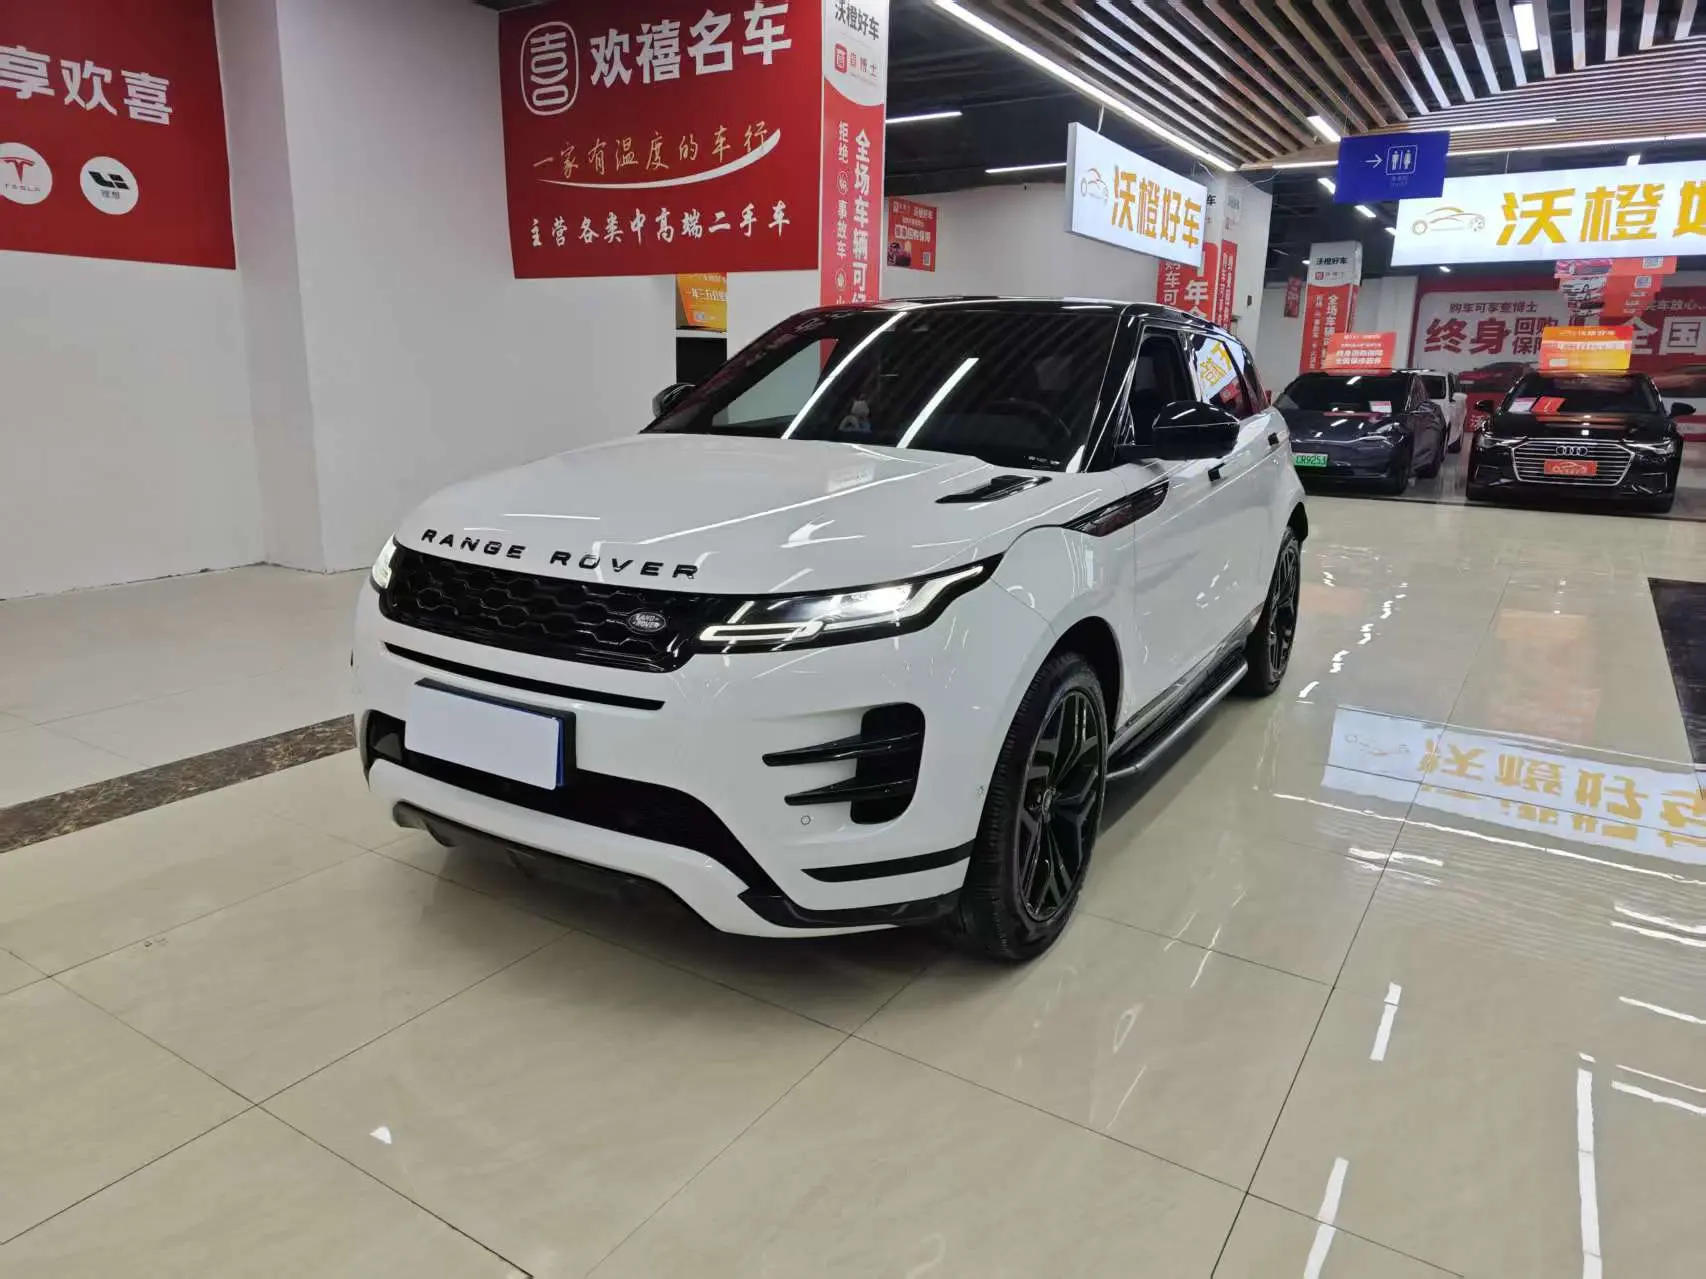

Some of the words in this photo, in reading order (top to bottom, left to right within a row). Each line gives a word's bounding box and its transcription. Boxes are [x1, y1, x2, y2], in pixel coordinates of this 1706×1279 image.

[590, 0, 792, 88] 欢禧名车
[834, 0, 880, 40] 沃橙好车
[0, 45, 173, 125] 享欢喜
[533, 120, 768, 179] 一家有温度的车行
[838, 121, 849, 164] 拒绝
[529, 200, 790, 247] 主营各类中高端二手车
[836, 199, 848, 259] 事故车
[1111, 164, 1202, 248] 沃橙好车
[1423, 317, 1512, 355] 终身
[421, 528, 527, 560] RANGE
[549, 550, 699, 580] ROVER
[635, 613, 656, 621] LAND
[636, 620, 661, 629] ROVER
